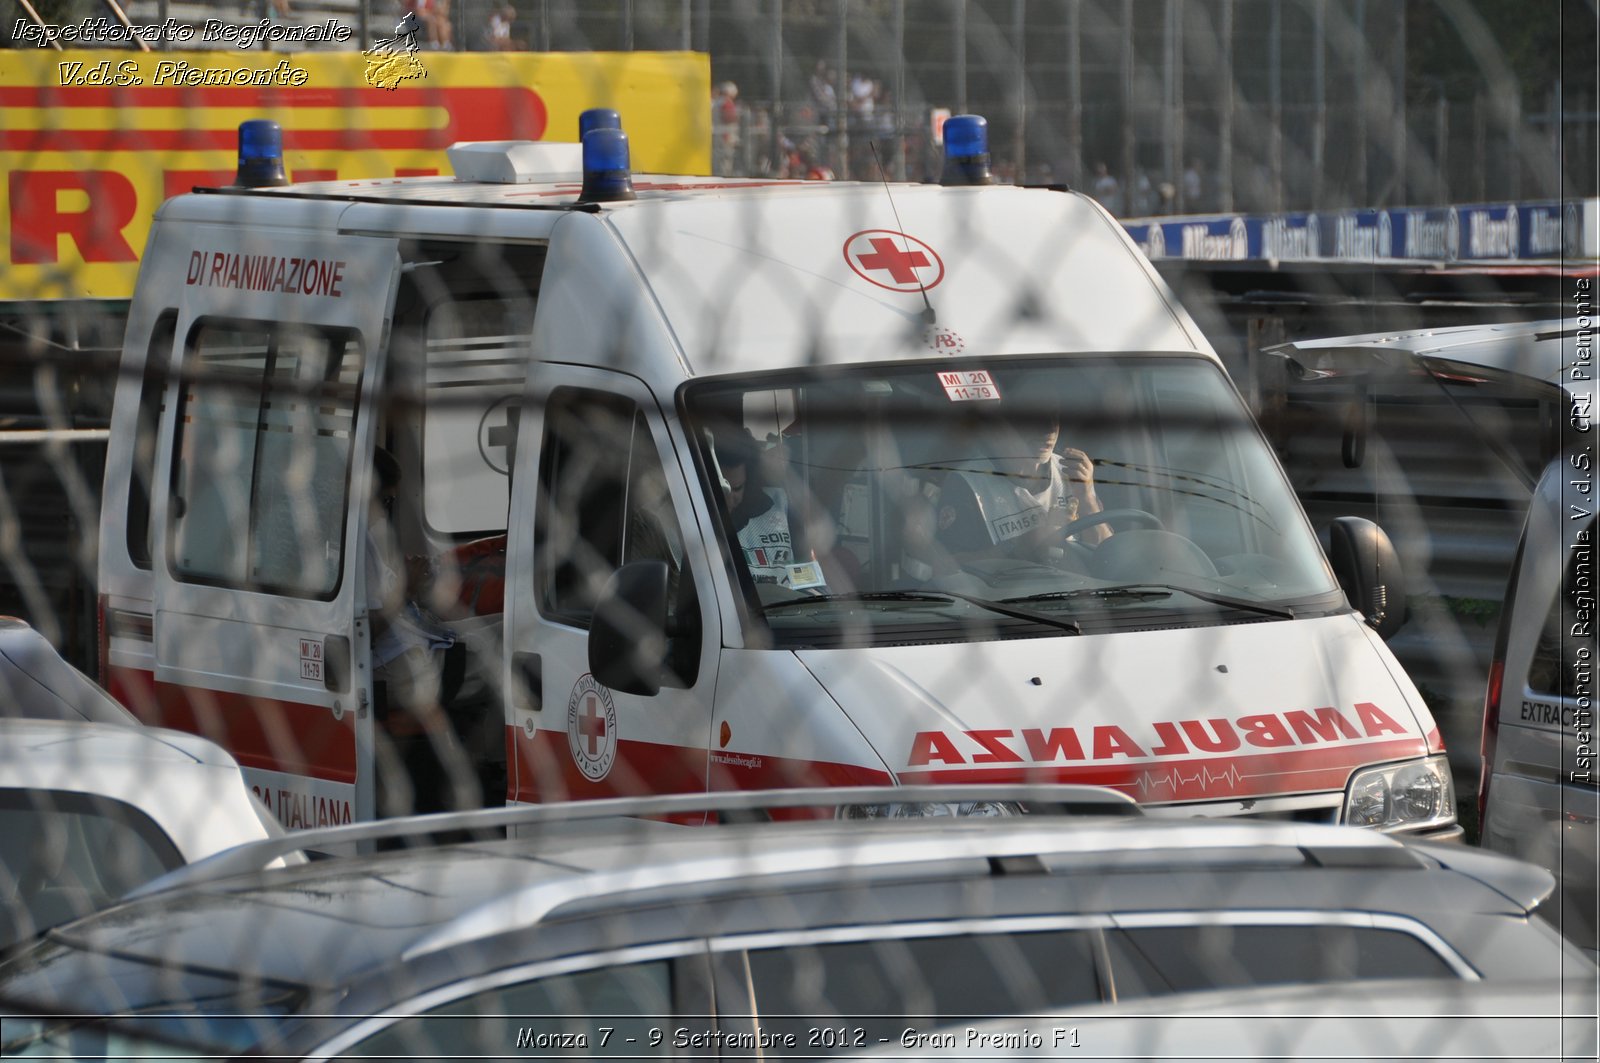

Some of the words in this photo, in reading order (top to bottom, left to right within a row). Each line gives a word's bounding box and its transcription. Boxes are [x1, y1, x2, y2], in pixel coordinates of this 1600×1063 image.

[186, 250, 208, 286] DI
[209, 252, 346, 298] RIANIMAZIONE
[943, 374, 961, 385] MI
[969, 373, 987, 384] 20
[955, 387, 991, 400] 11-79
[760, 532, 790, 544] 2012
[278, 789, 352, 829] ITALIANA
